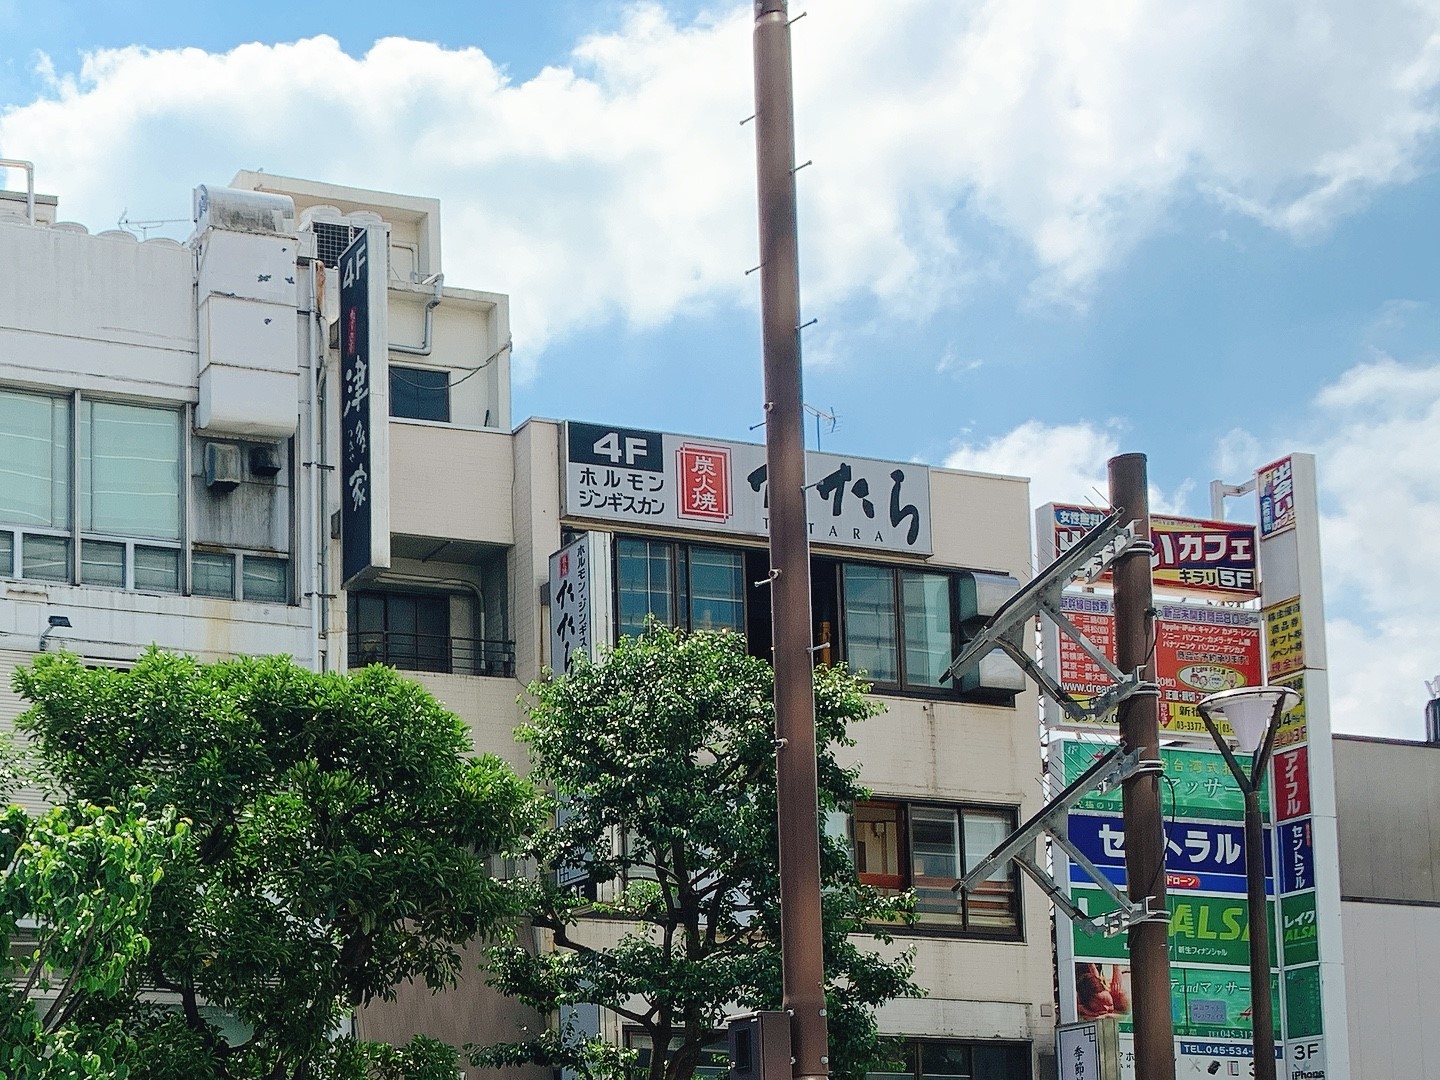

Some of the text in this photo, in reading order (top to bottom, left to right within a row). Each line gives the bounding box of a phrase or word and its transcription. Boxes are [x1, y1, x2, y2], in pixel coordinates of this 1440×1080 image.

[593, 432, 649, 465] 4F
[579, 467, 665, 493] ホルモン
[690, 454, 719, 513] 炭火焼
[578, 490, 666, 516] ジンギスカン
[762, 517, 885, 543] TTARA
[1179, 568, 1216, 586] キラリ
[1219, 572, 1252, 587] 5F
[576, 544, 588, 648] ホルモン・ジンギス
[1283, 751, 1301, 815] アイフル
[1098, 823, 1242, 865] セトラル
[1291, 824, 1307, 889] セントラル
[1168, 903, 1249, 942] ALS
[1284, 923, 1316, 939] ALSA
[1285, 909, 1316, 928] レイク
[1293, 1043, 1319, 1061] 3F
[1291, 1070, 1325, 1080] iPhone
